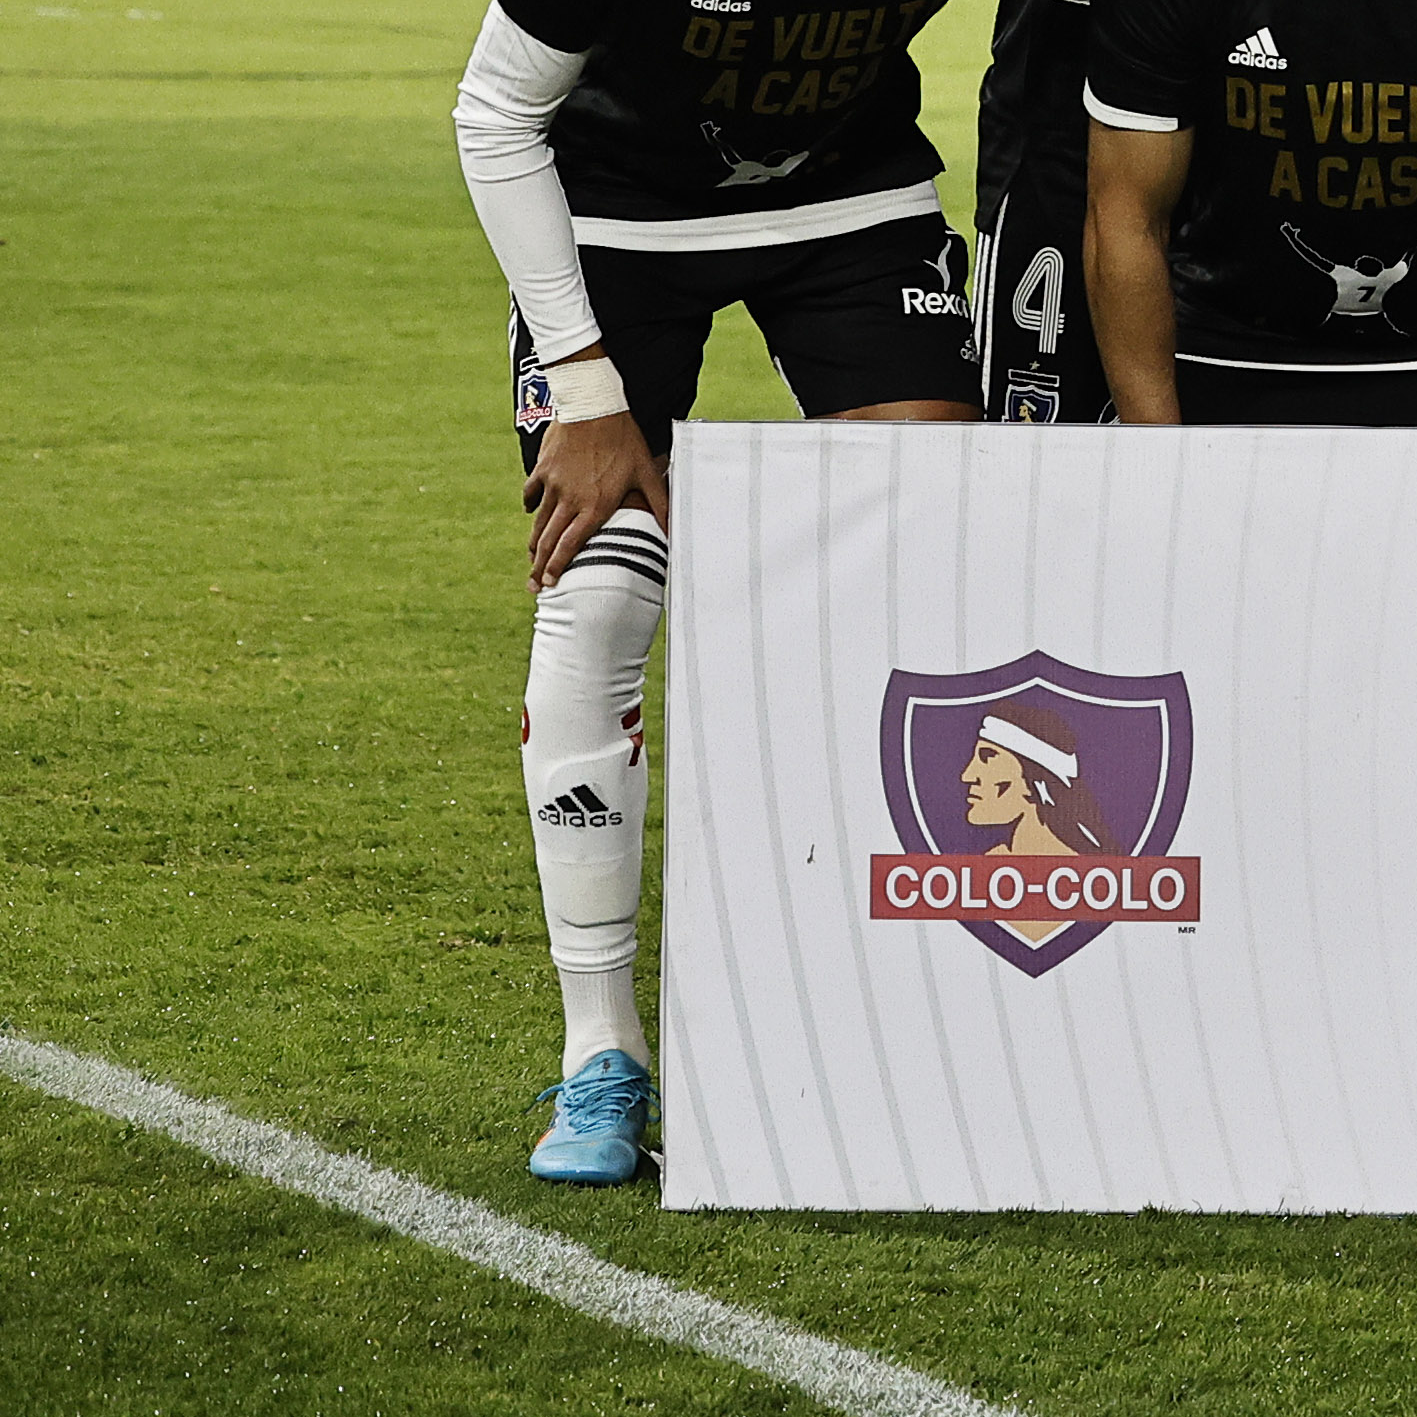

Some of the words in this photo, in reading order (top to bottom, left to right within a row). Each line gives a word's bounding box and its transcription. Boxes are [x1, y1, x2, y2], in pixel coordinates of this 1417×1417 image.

[681, 15, 754, 62] DE
[1228, 50, 1289, 71] adidas
[700, 69, 740, 110] A
[1225, 75, 1288, 141] DE
[1267, 150, 1303, 202] A
[1012, 246, 1066, 355] 4
[1357, 286, 1377, 303] 7
[885, 865, 1187, 911] COLO-COLO
[1177, 926, 1197, 934] MR
